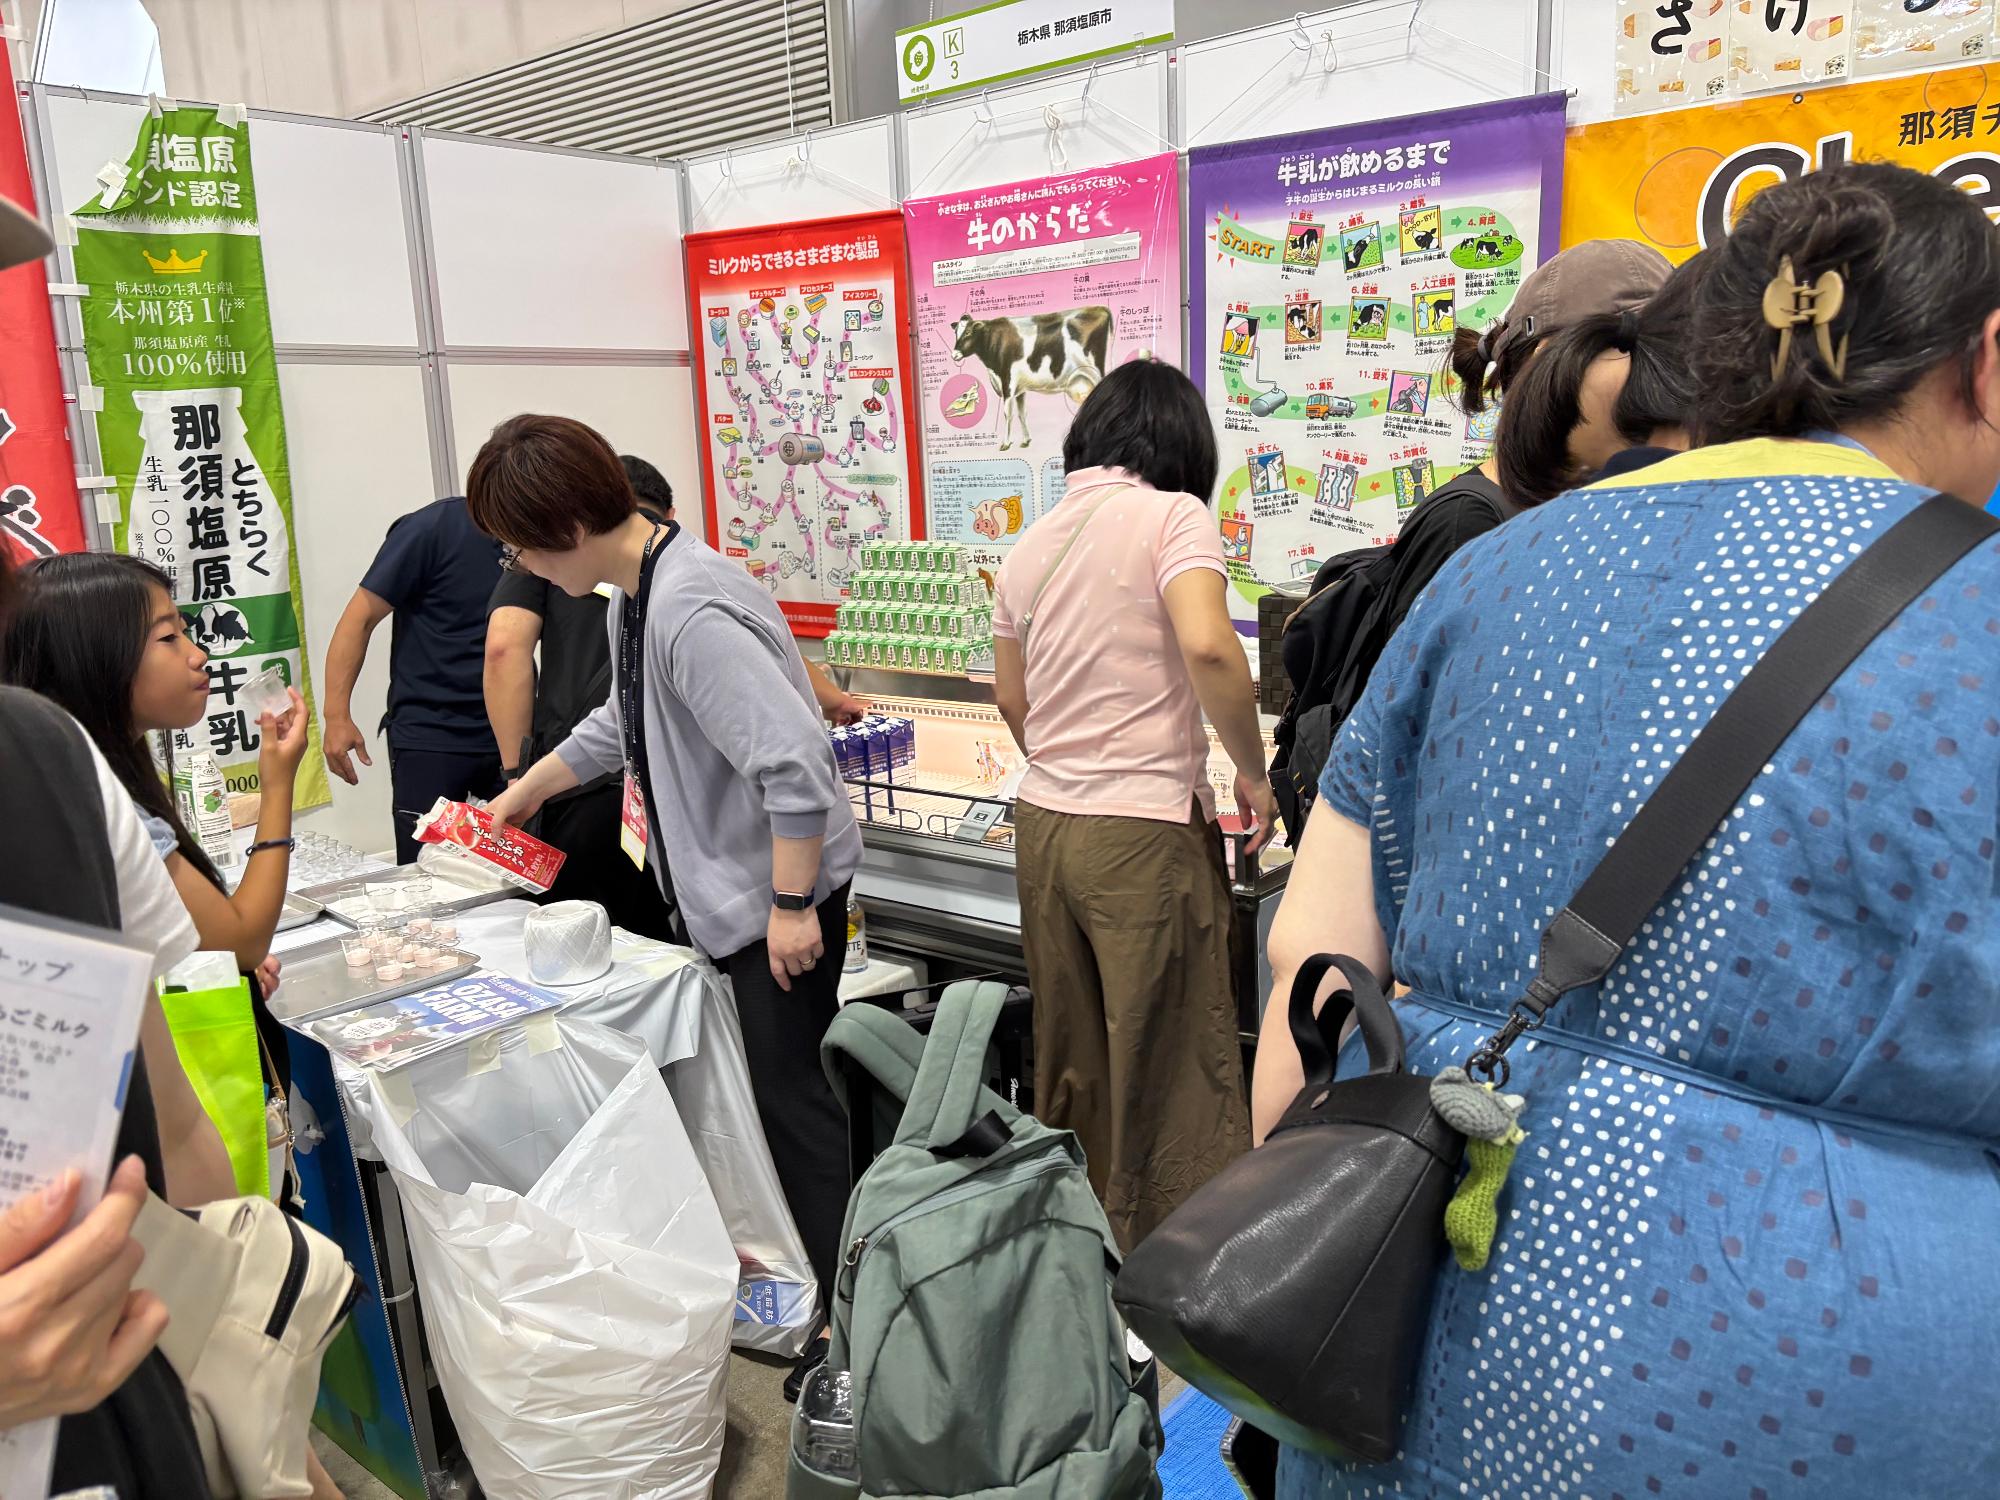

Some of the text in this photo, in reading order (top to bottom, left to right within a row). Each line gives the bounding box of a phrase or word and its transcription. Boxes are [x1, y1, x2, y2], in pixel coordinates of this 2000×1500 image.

[948, 33, 959, 52] K
[1017, 8, 1112, 47] 栃木県 那須塩原市
[950, 61, 959, 80] 3
[1277, 140, 1451, 187] 牛乳が飲めるまで
[1285, 176, 1441, 207] 子牛の誕生からはじまるミルクの長い旅
[967, 200, 1093, 251] 牛のからだ
[708, 240, 880, 276] ミルクからできるさまざまな製品
[1220, 227, 1275, 260] START
[801, 283, 834, 294] プロセスチーズ
[844, 291, 878, 299] アイスクリーム
[123, 351, 247, 376] 100%使用
[231, 458, 270, 576] とちらく
[170, 404, 236, 602] 那須塩原
[204, 661, 260, 756] 牛乳
[418, 992, 491, 1026] FARM
[764, 1284, 774, 1321] 低脂肪
